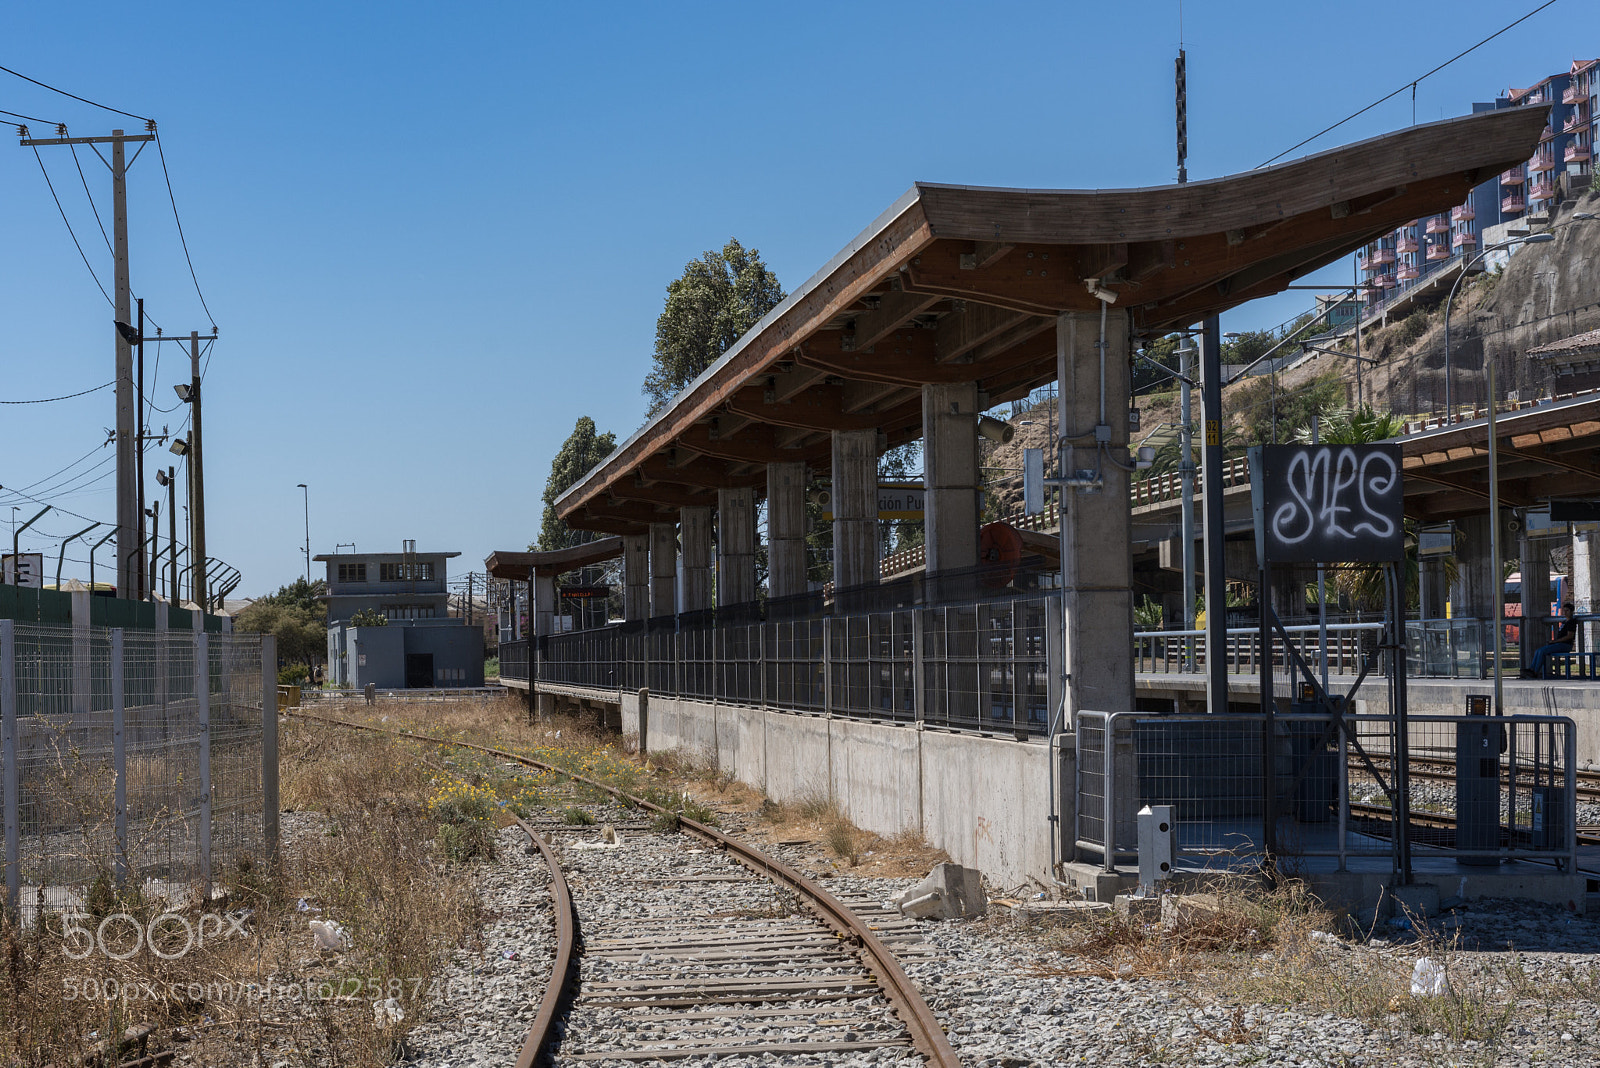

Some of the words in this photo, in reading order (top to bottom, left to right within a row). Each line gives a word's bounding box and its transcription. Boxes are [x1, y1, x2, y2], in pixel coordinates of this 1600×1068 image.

[1206, 421, 1217, 431] 02
[1207, 434, 1216, 444] 11
[878, 495, 902, 510] ción
[1482, 738, 1489, 748] 3
